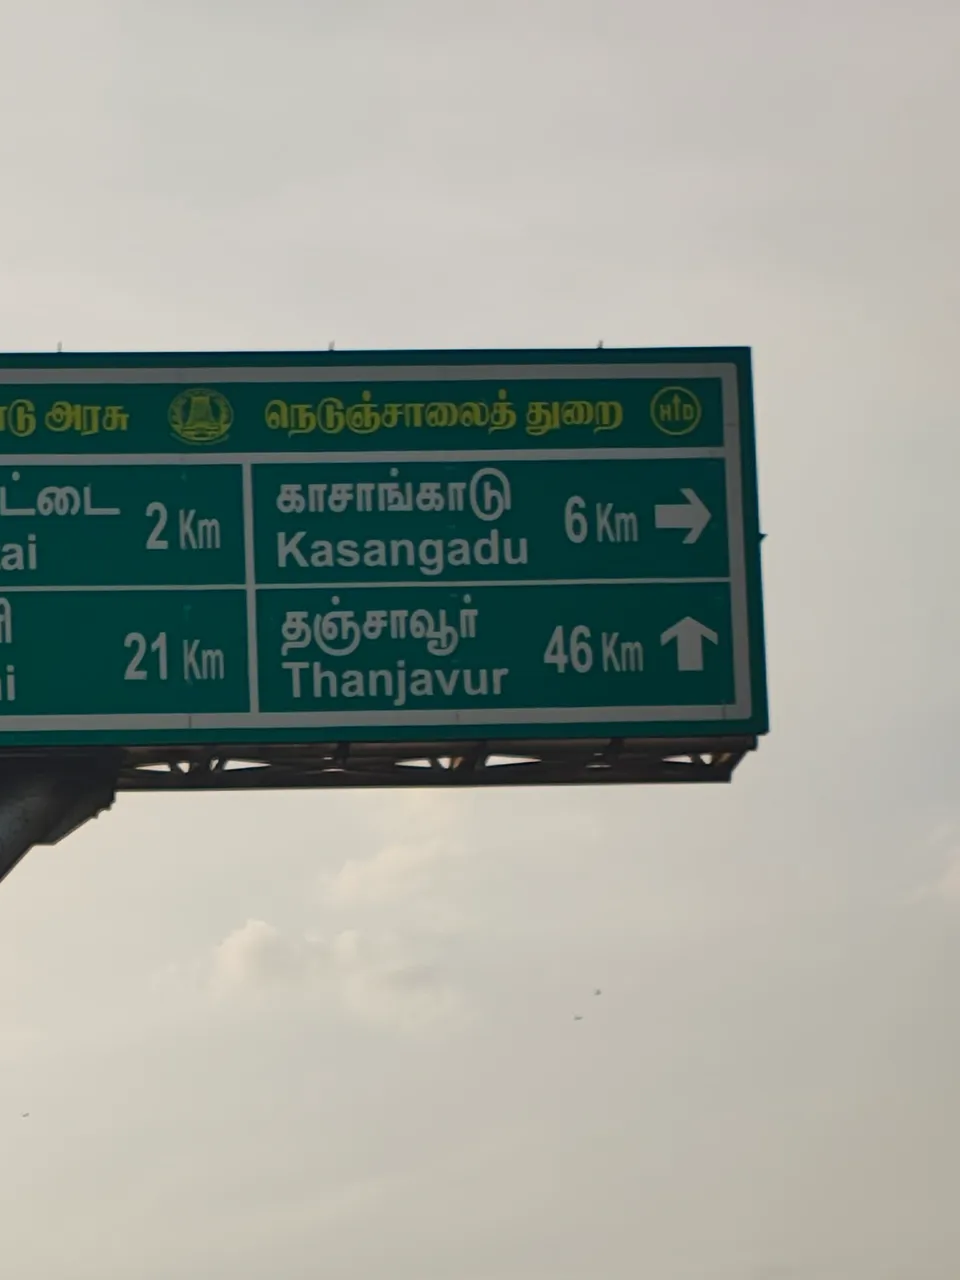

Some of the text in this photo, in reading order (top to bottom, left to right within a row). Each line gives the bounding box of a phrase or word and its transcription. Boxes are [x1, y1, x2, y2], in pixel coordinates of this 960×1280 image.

[45, 401, 129, 435] அரசு
[265, 389, 623, 436] நெடுஞ்சாலைத் துறை
[277, 468, 511, 521] காசாங்காடு
[146, 502, 220, 549] 2 Km
[565, 496, 637, 543] 6 Km
[278, 529, 527, 575] Kasangadu
[281, 594, 478, 656] தஞ்சாவூர்
[544, 625, 643, 672] 46 Km
[124, 632, 224, 680] 21 Km
[282, 660, 508, 706] Thanjavur
